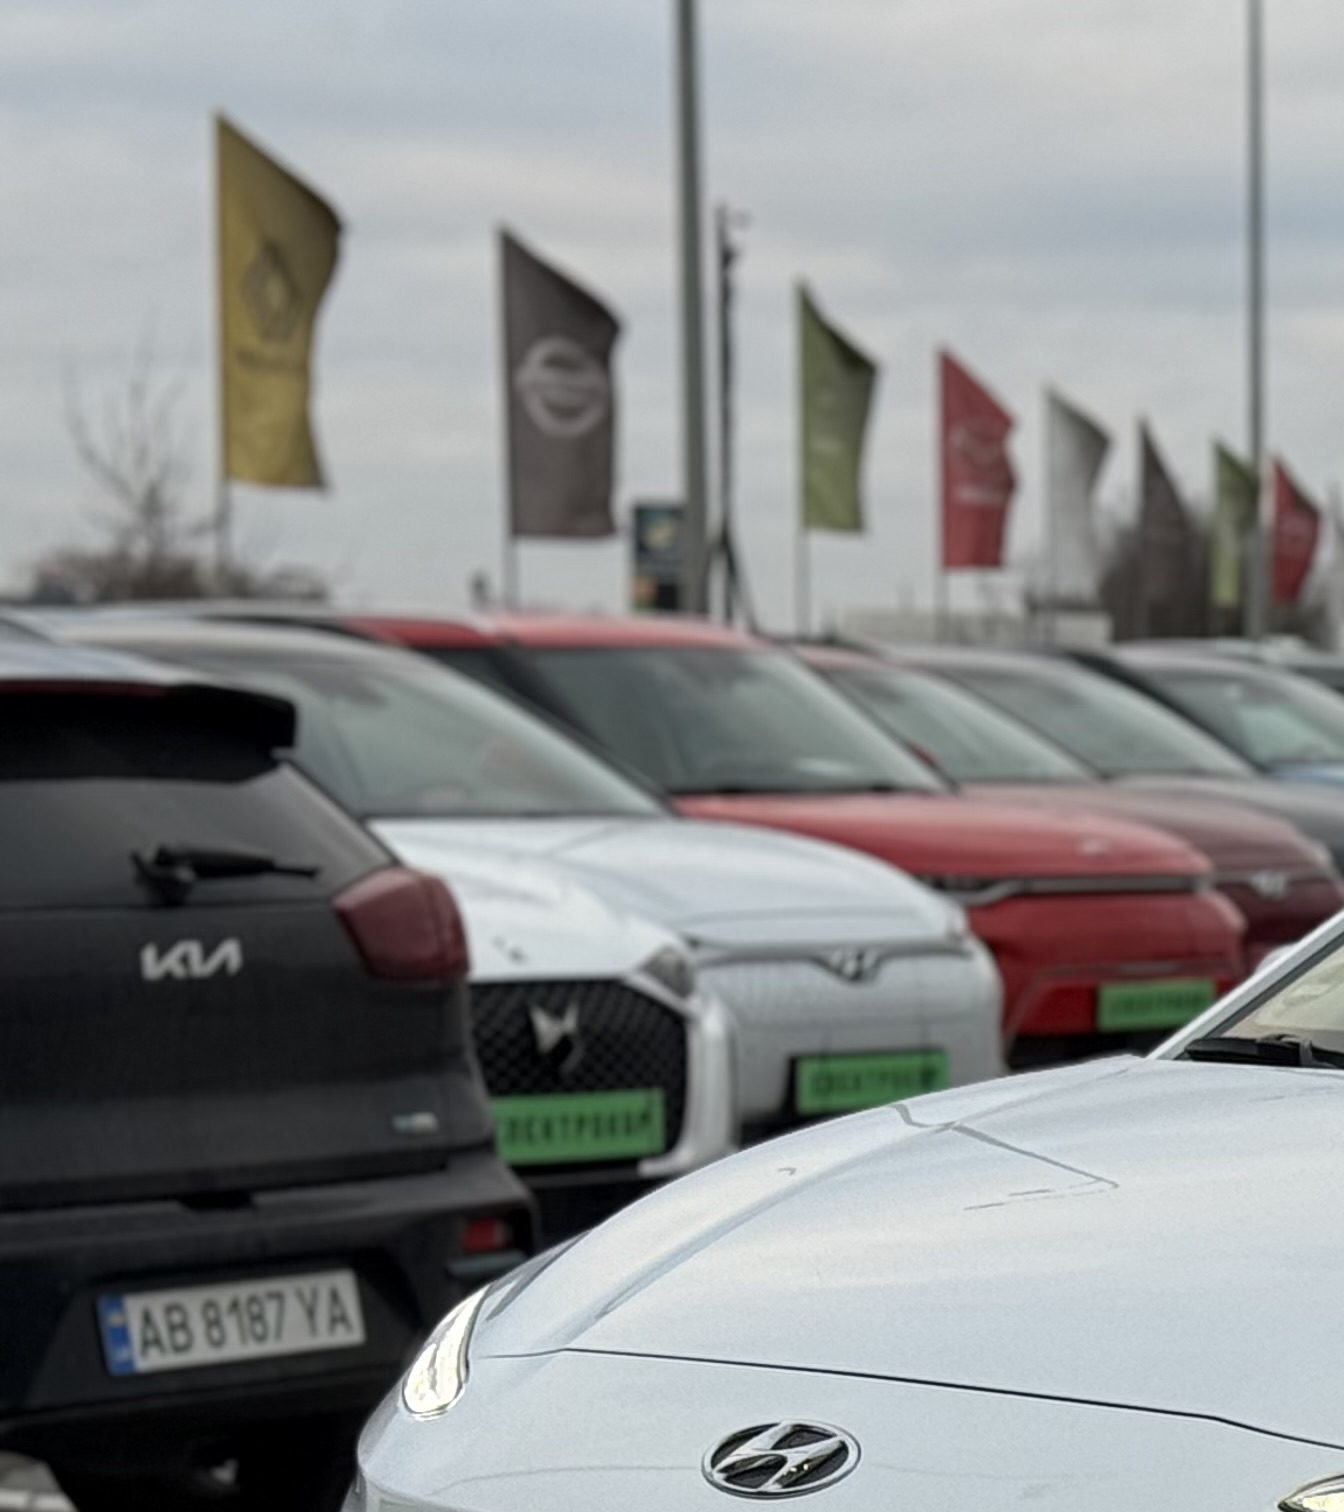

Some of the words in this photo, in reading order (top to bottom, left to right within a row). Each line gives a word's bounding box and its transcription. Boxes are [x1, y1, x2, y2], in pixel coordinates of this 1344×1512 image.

[141, 938, 242, 981] KIA
[139, 1302, 194, 1359] AB
[201, 1290, 286, 1348] 8187
[295, 1284, 354, 1337] YA
